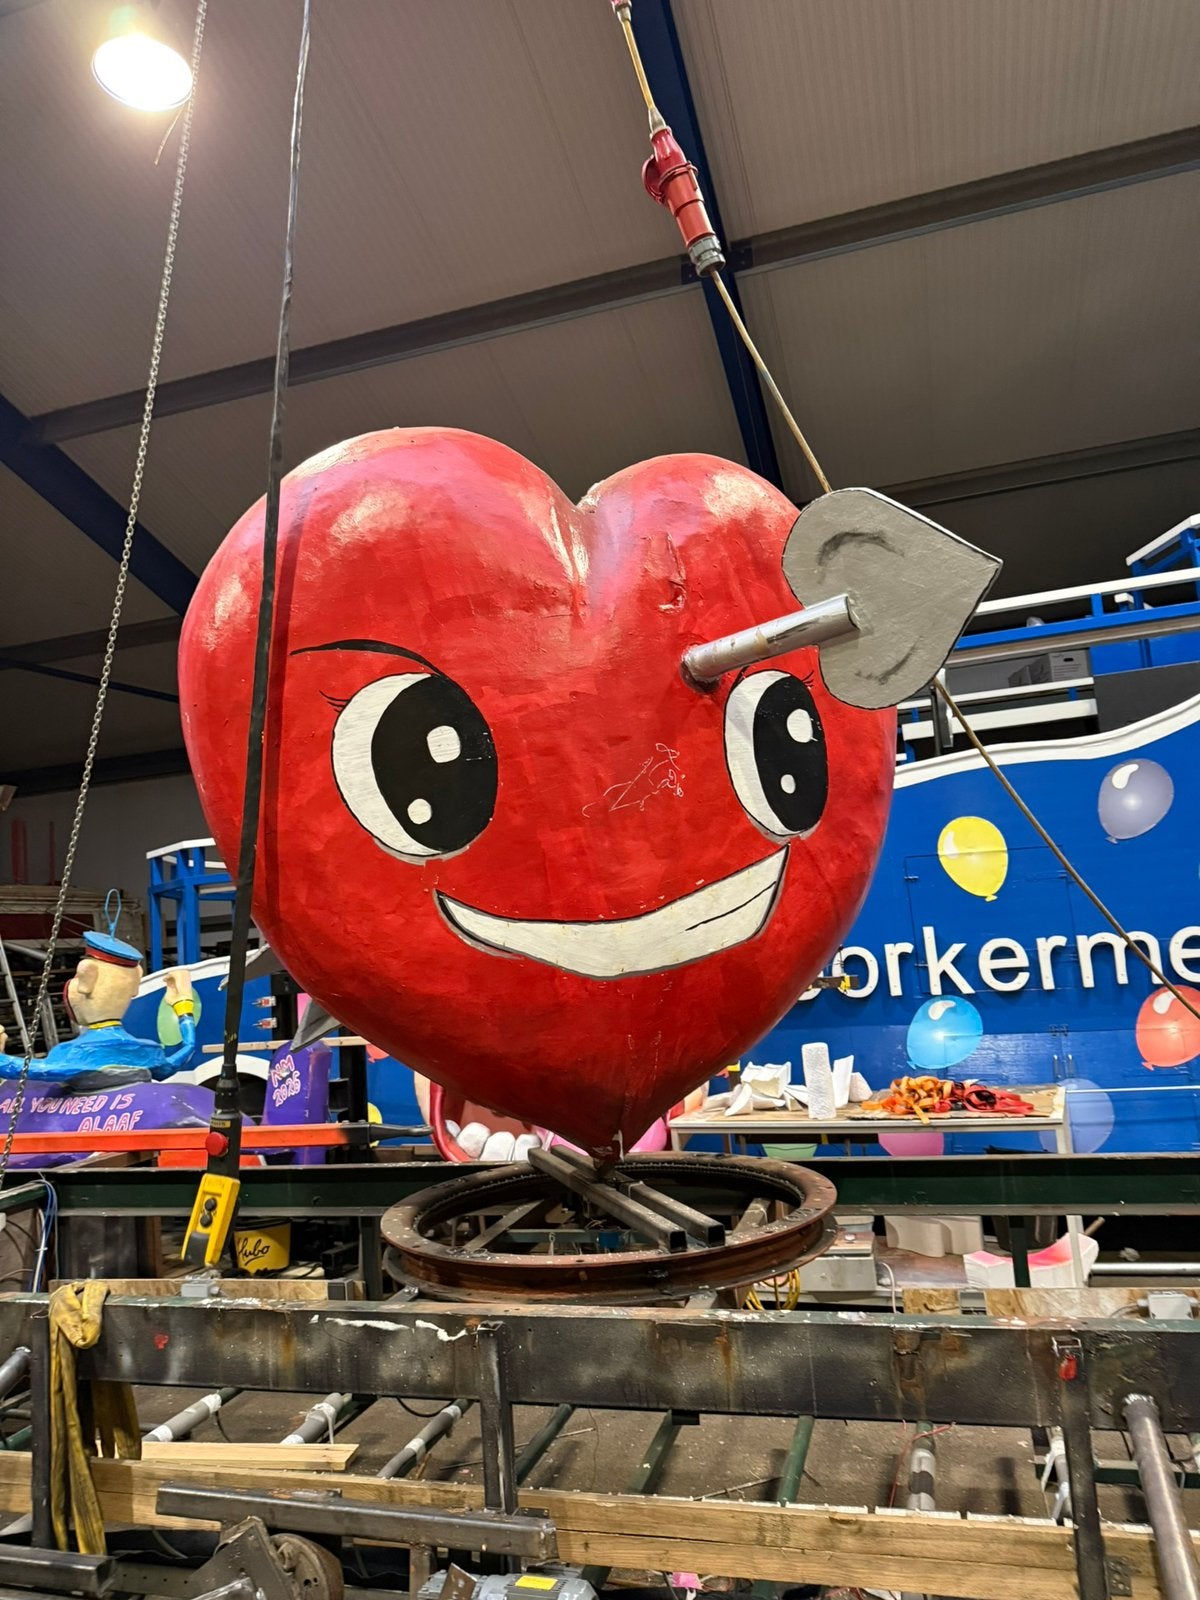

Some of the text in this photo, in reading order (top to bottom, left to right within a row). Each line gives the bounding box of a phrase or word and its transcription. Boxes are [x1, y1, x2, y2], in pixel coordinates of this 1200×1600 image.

[798, 925, 1200, 1001] orkerme
[271, 1054, 296, 1088] NM
[272, 1070, 302, 1107] 2026
[30, 1097, 64, 1114] YOU
[59, 1095, 109, 1116] NEED
[109, 1093, 136, 1111] IS
[77, 1110, 144, 1132] ALAAF
[237, 1237, 271, 1263] Hubo
